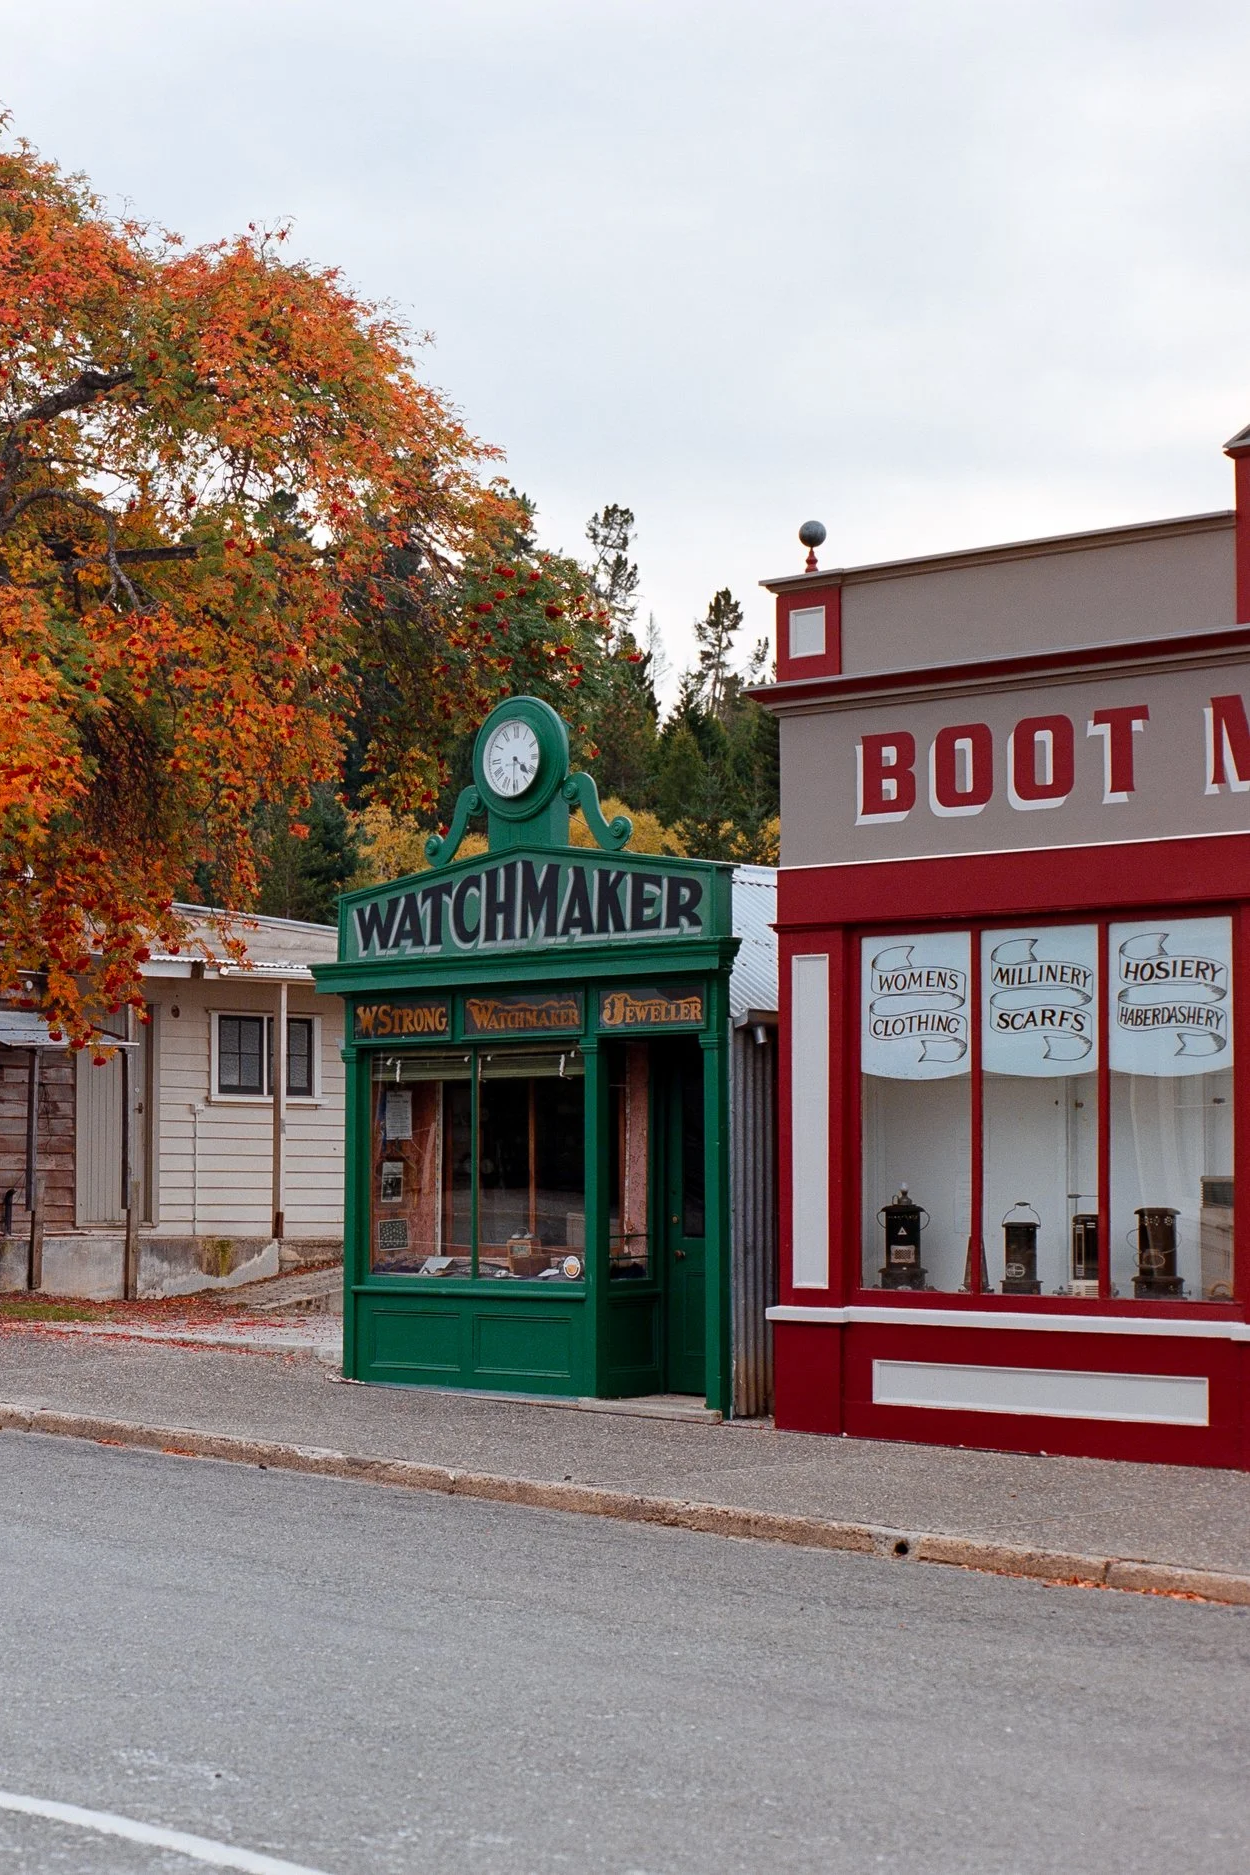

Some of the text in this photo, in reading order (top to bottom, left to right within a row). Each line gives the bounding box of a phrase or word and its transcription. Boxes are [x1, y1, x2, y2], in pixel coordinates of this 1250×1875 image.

[855, 704, 1150, 826] BOOT
[353, 860, 704, 957] WATCHMAKER
[993, 964, 1093, 989] MILLINERY
[1123, 959, 1225, 984] HOSIERY
[466, 999, 581, 1032] WATCHMAKER
[603, 993, 703, 1025] JEWELLER
[996, 1009, 1087, 1032] SCARFS
[1119, 1005, 1225, 1031] HABERDASHERY
[872, 1014, 961, 1037] CLOTHING
